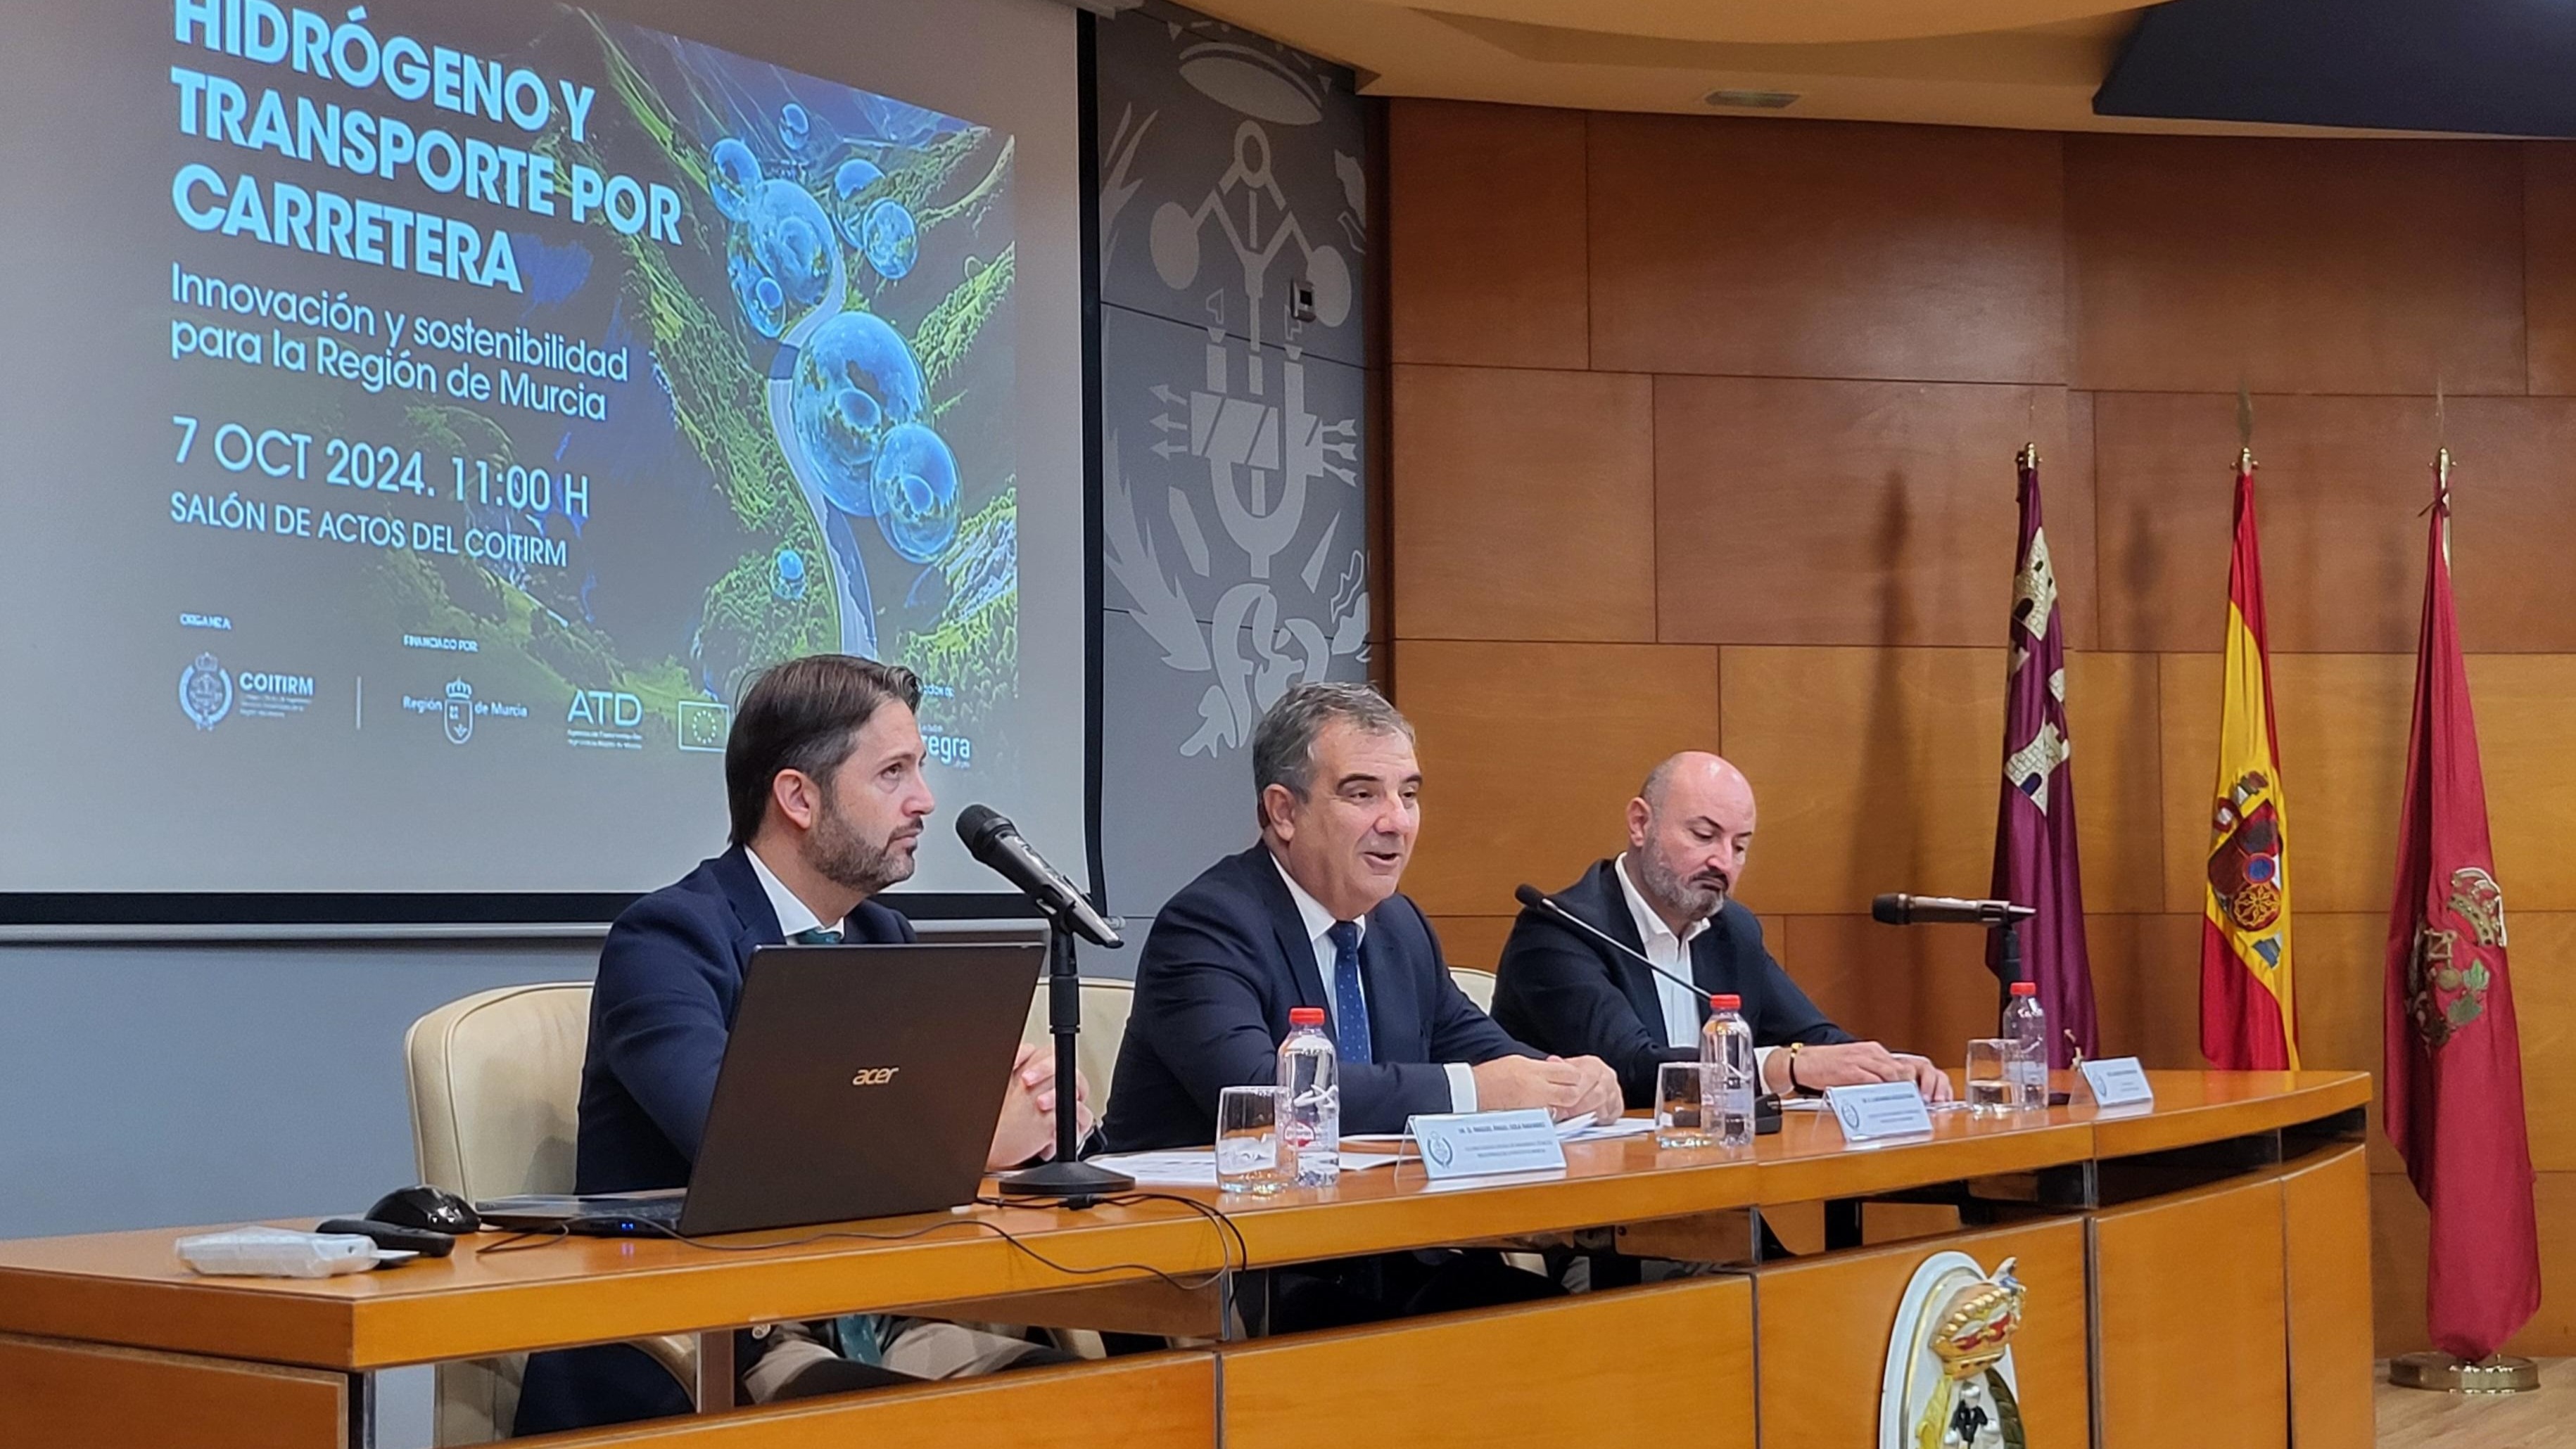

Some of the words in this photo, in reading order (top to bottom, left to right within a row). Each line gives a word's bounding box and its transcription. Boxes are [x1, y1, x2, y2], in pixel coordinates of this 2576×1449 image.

[174, 0, 550, 132] HIDRÓGENO
[559, 80, 595, 143] Y
[170, 67, 556, 217] TRANSPORTE
[571, 165, 683, 246] POR
[172, 163, 524, 293] CARRETERA
[170, 319, 262, 362] para
[273, 330, 306, 371] la
[317, 336, 437, 393] Región
[446, 363, 491, 401] de
[500, 369, 607, 421] Murcia
[172, 263, 375, 336] Innovación
[385, 313, 405, 347] y
[413, 317, 629, 382] sostenibilidad
[172, 416, 198, 464] 7
[214, 423, 312, 479] OCT
[325, 439, 435, 497] 2024.
[452, 457, 550, 513] 11:00
[564, 473, 589, 518] H
[170, 490, 266, 532] SALÓN
[274, 504, 310, 537] DE
[318, 511, 406, 549] ACTOS
[412, 522, 459, 555] DEL
[465, 528, 567, 567] COITIRM
[239, 672, 314, 696] COITIRM
[403, 696, 443, 713] Región
[474, 701, 488, 715] de
[491, 702, 528, 717] Murcia
[567, 689, 643, 727] ATD
[852, 1067, 899, 1085] acer
